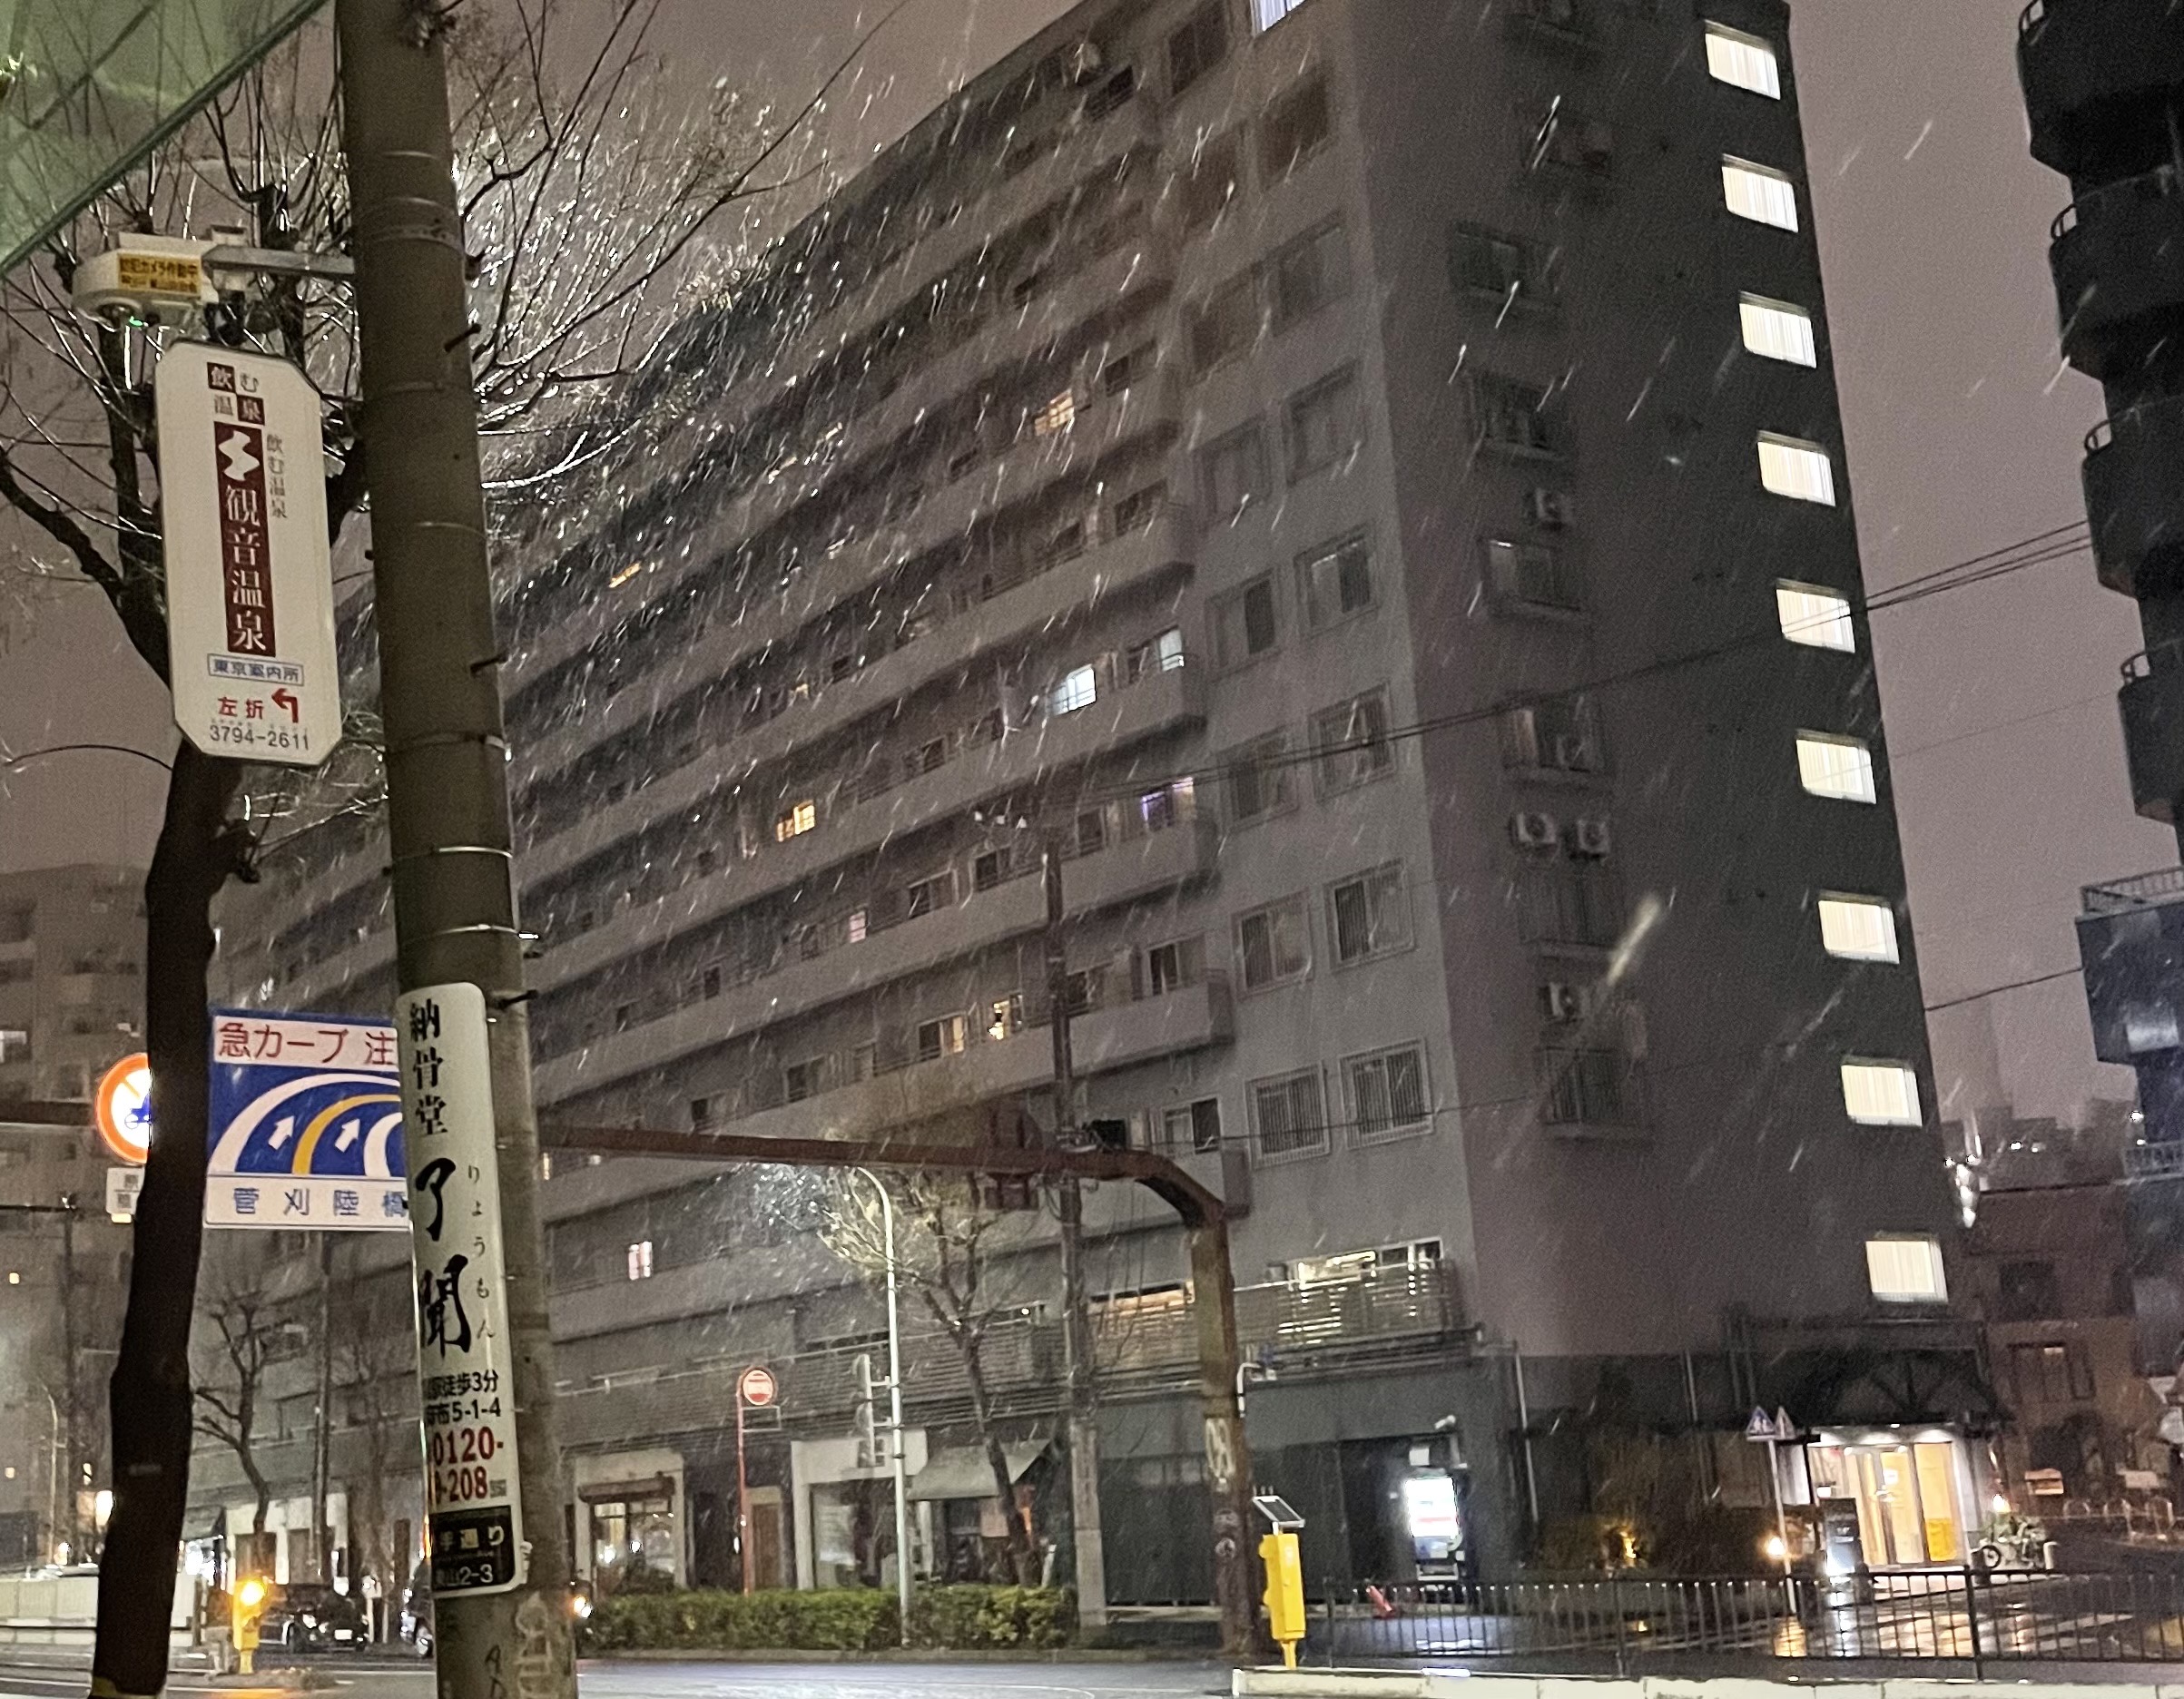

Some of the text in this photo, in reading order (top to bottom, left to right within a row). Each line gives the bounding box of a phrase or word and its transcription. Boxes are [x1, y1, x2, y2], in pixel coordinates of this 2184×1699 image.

[227, 485, 267, 651] 観音温泉
[213, 658, 300, 683] 東京案内所
[218, 696, 264, 720] 左折
[210, 725, 310, 751] 3794-2611
[408, 998, 448, 1136] 納骨堂
[467, 1164, 496, 1340] りょうもん
